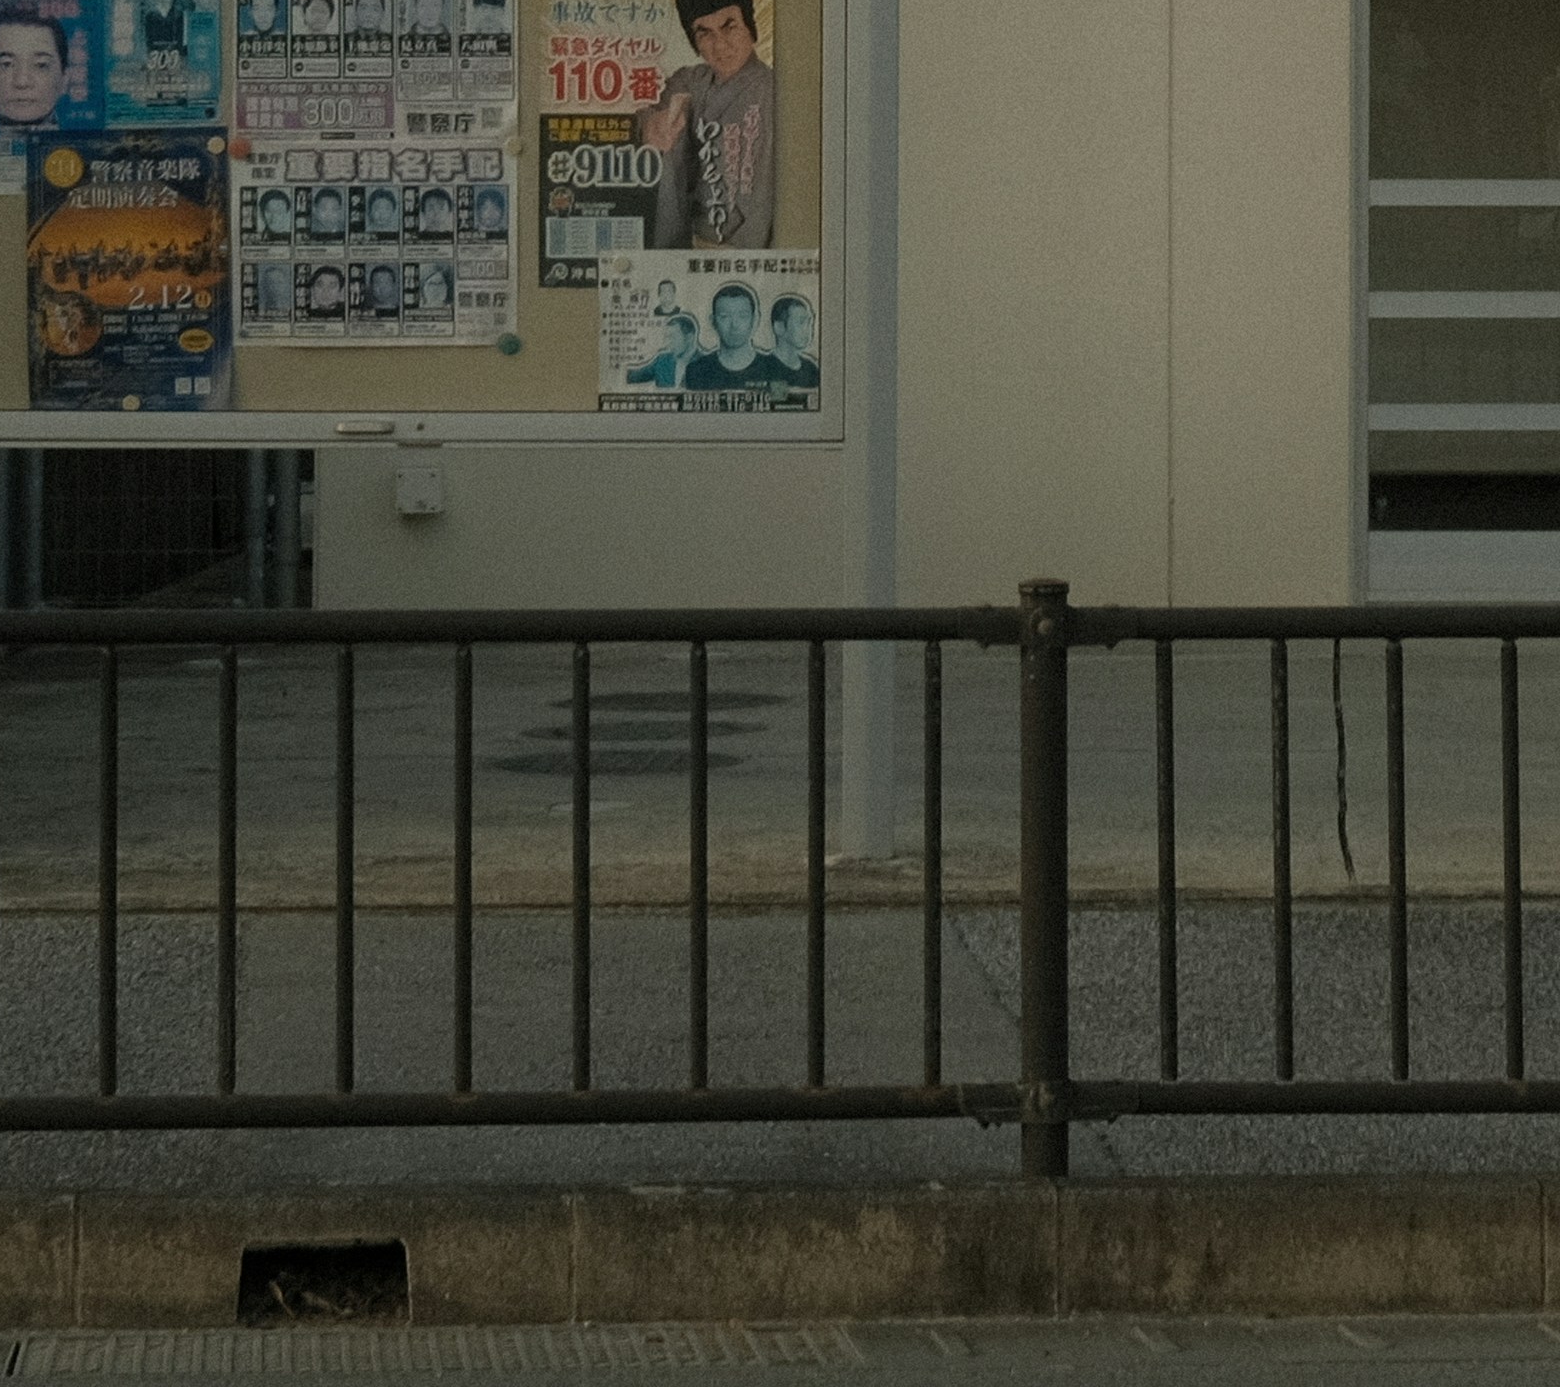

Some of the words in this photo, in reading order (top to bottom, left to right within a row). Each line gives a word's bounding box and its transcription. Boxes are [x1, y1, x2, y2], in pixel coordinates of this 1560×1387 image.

[552, 2, 666, 23] 事故ですか
[549, 37, 662, 58] 緊急ダイヤル
[548, 60, 663, 101] 110番
[303, 97, 353, 126] 300
[285, 149, 504, 182] 重要指名手配
[548, 145, 663, 188] #9110
[68, 185, 179, 210] 定期演奏会
[128, 284, 193, 310] 2.12
